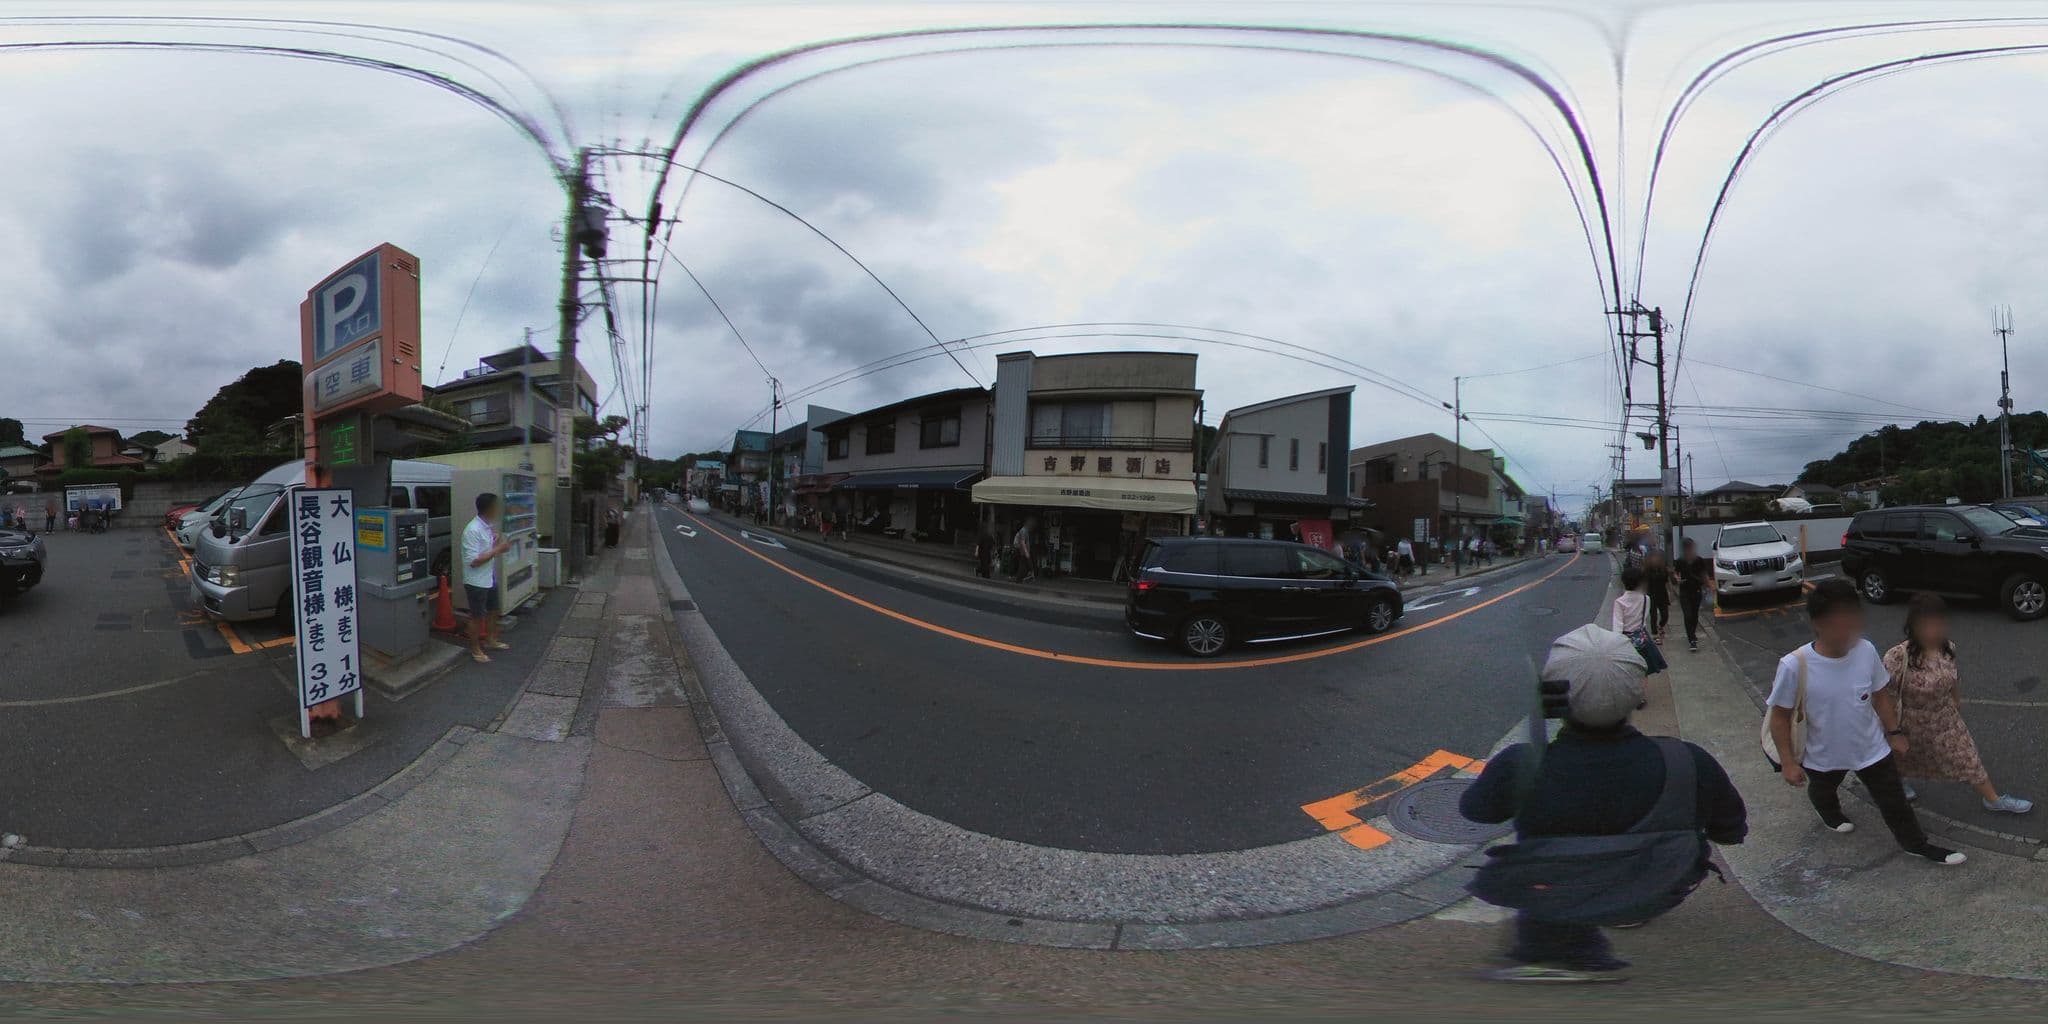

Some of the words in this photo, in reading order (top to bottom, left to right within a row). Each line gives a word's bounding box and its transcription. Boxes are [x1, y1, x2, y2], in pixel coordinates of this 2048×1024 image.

[322, 273, 368, 353] P
[343, 314, 370, 341] 入口
[325, 356, 371, 396] 空車
[330, 424, 355, 465] 空
[1044, 456, 1170, 474] 吉野屋酒店
[1645, 499, 1654, 509] P
